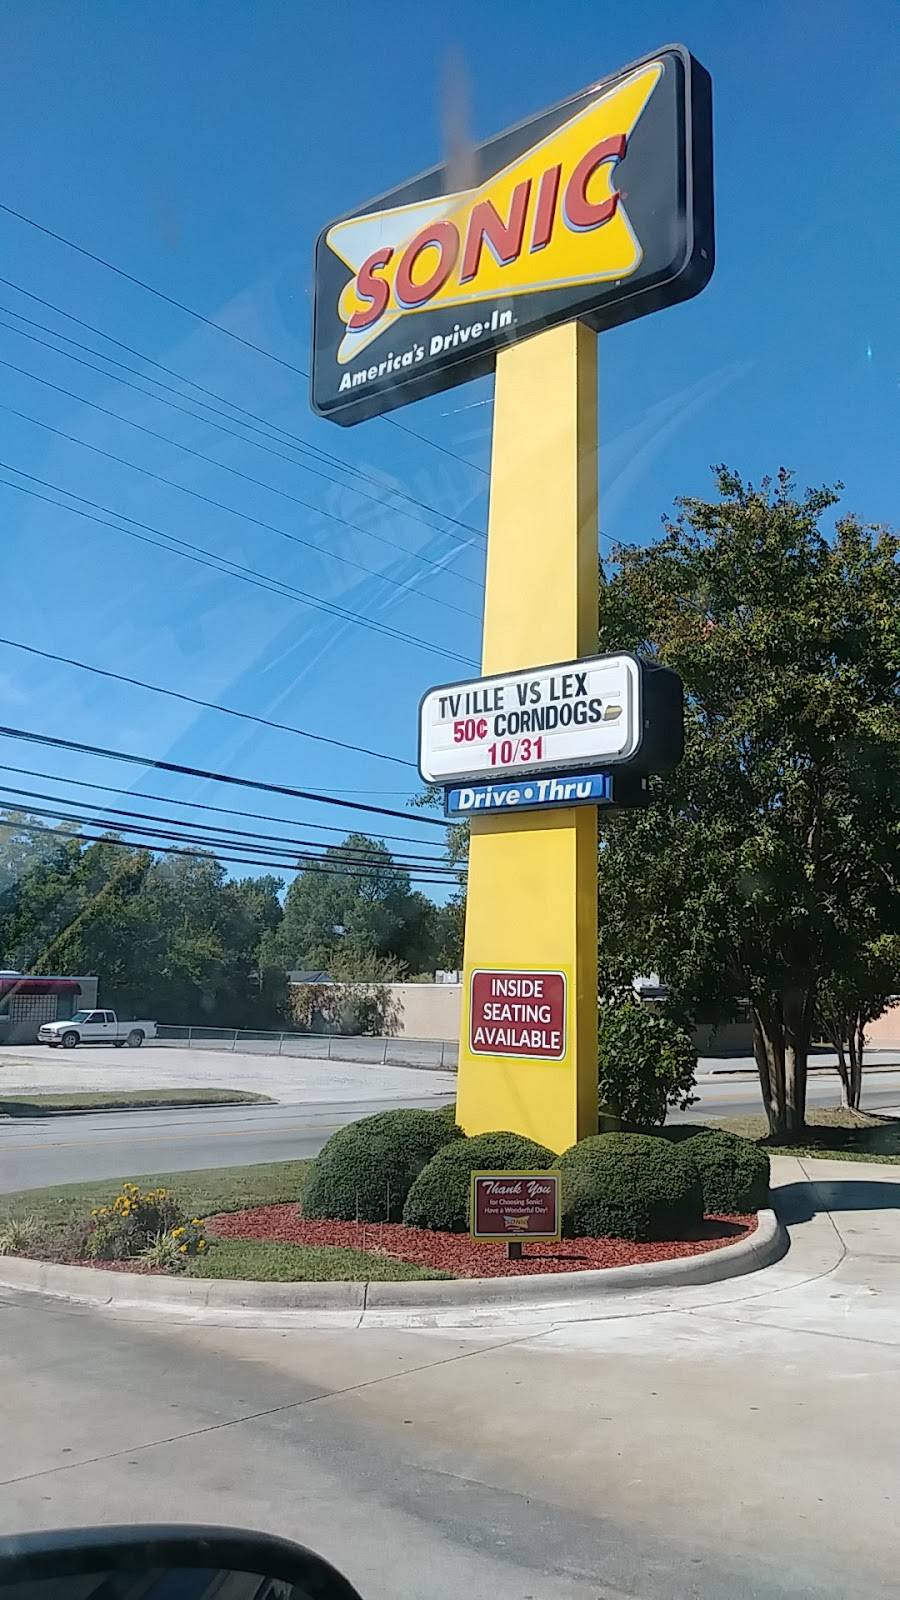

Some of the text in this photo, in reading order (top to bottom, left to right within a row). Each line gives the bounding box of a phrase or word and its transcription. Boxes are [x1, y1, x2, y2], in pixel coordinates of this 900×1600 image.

[346, 133, 627, 331] SONIC
[339, 343, 424, 392] America's
[516, 681, 542, 706] VS
[550, 672, 588, 701] LEX
[453, 699, 603, 743] 50¢ CORNDOGS
[488, 736, 543, 766] 10/31
[491, 978, 544, 998] INSIDE
[483, 1002, 551, 1023] SEATING
[473, 1026, 561, 1049] AVAILABLE
[482, 1180, 552, 1198] Thank You
